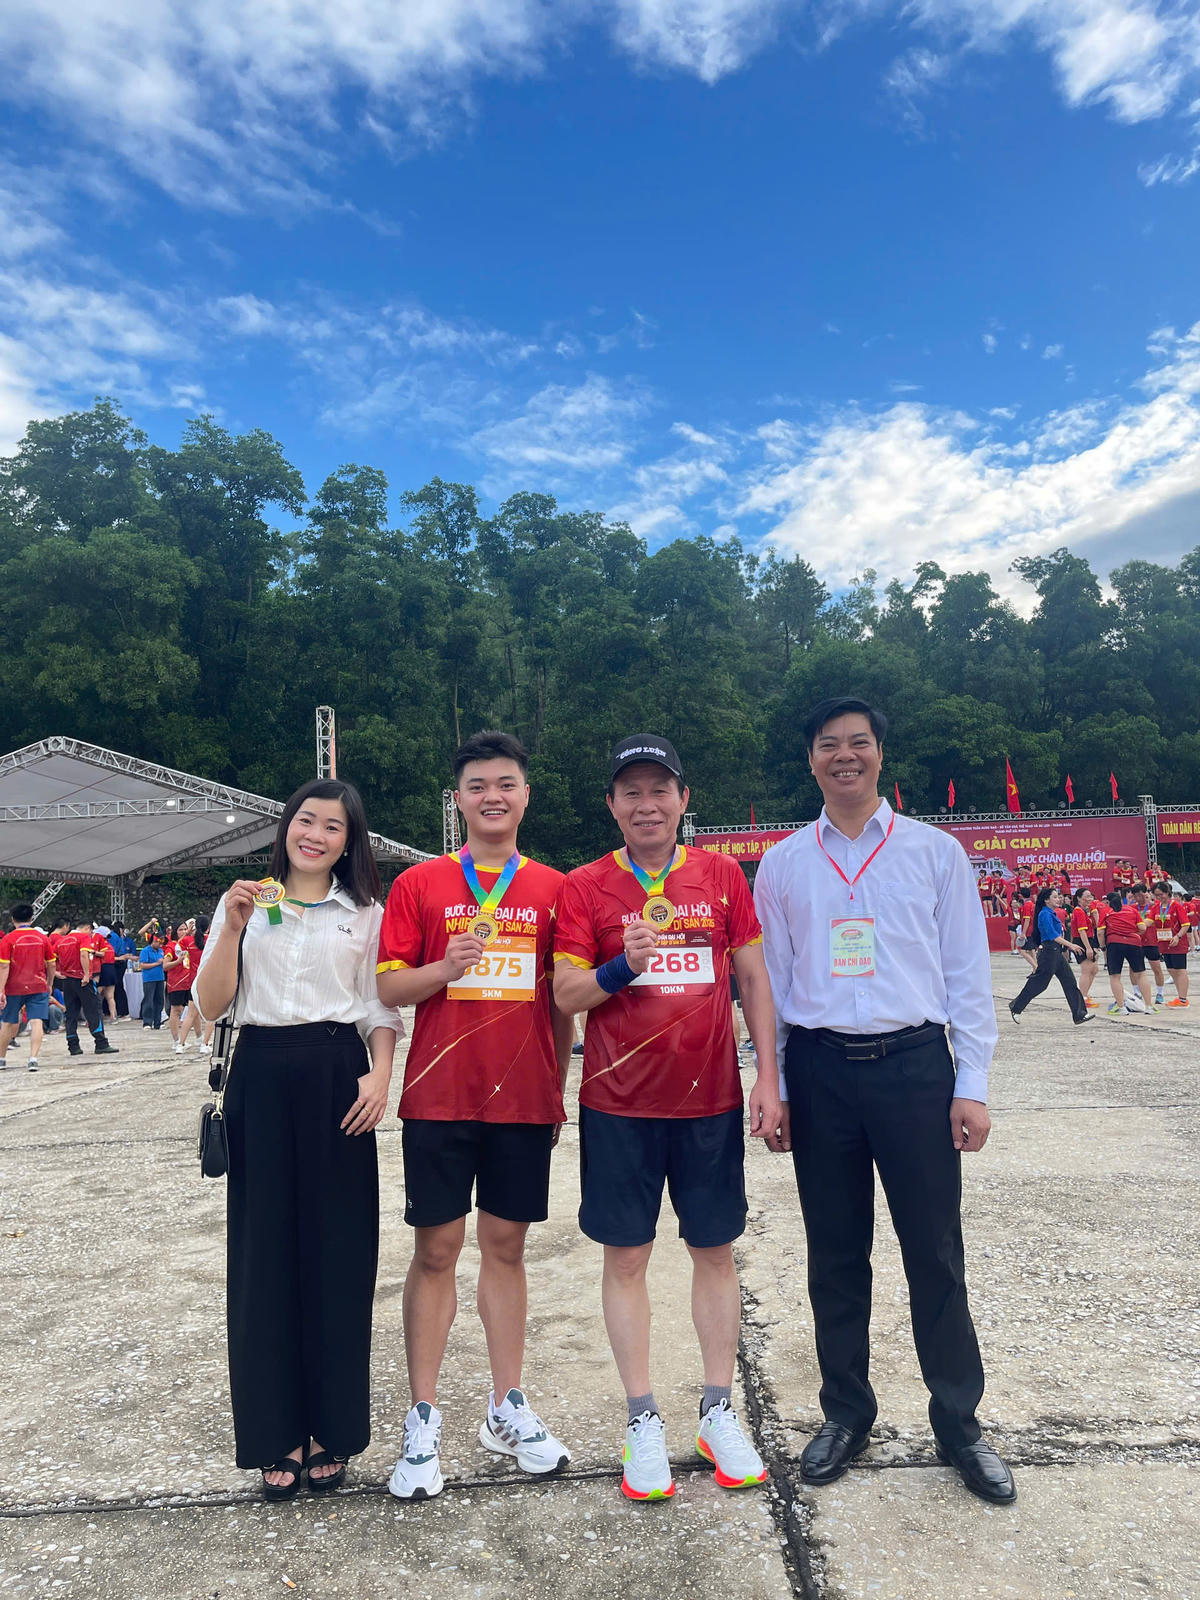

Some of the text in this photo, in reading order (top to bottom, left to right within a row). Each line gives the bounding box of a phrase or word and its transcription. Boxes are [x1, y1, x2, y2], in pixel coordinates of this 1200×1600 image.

[1179, 821, 1192, 834] DÂN
[732, 843, 745, 856] HỌC
[973, 836, 1051, 851] GIẢI CHẠY
[1038, 852, 1063, 864] CHÂN
[1065, 852, 1082, 865] ĐẠI
[1086, 850, 1105, 863] HỘI
[445, 904, 537, 923] BƯỚC CH ĐẠI HỘI
[692, 902, 711, 918] HỘI
[505, 920, 521, 933] SẢN
[522, 922, 538, 935] 2025
[684, 918, 700, 929] SẢN
[702, 918, 715, 927] 2025
[644, 953, 700, 973] 268
[482, 990, 502, 998] 5KM
[660, 986, 685, 994] 10KM
